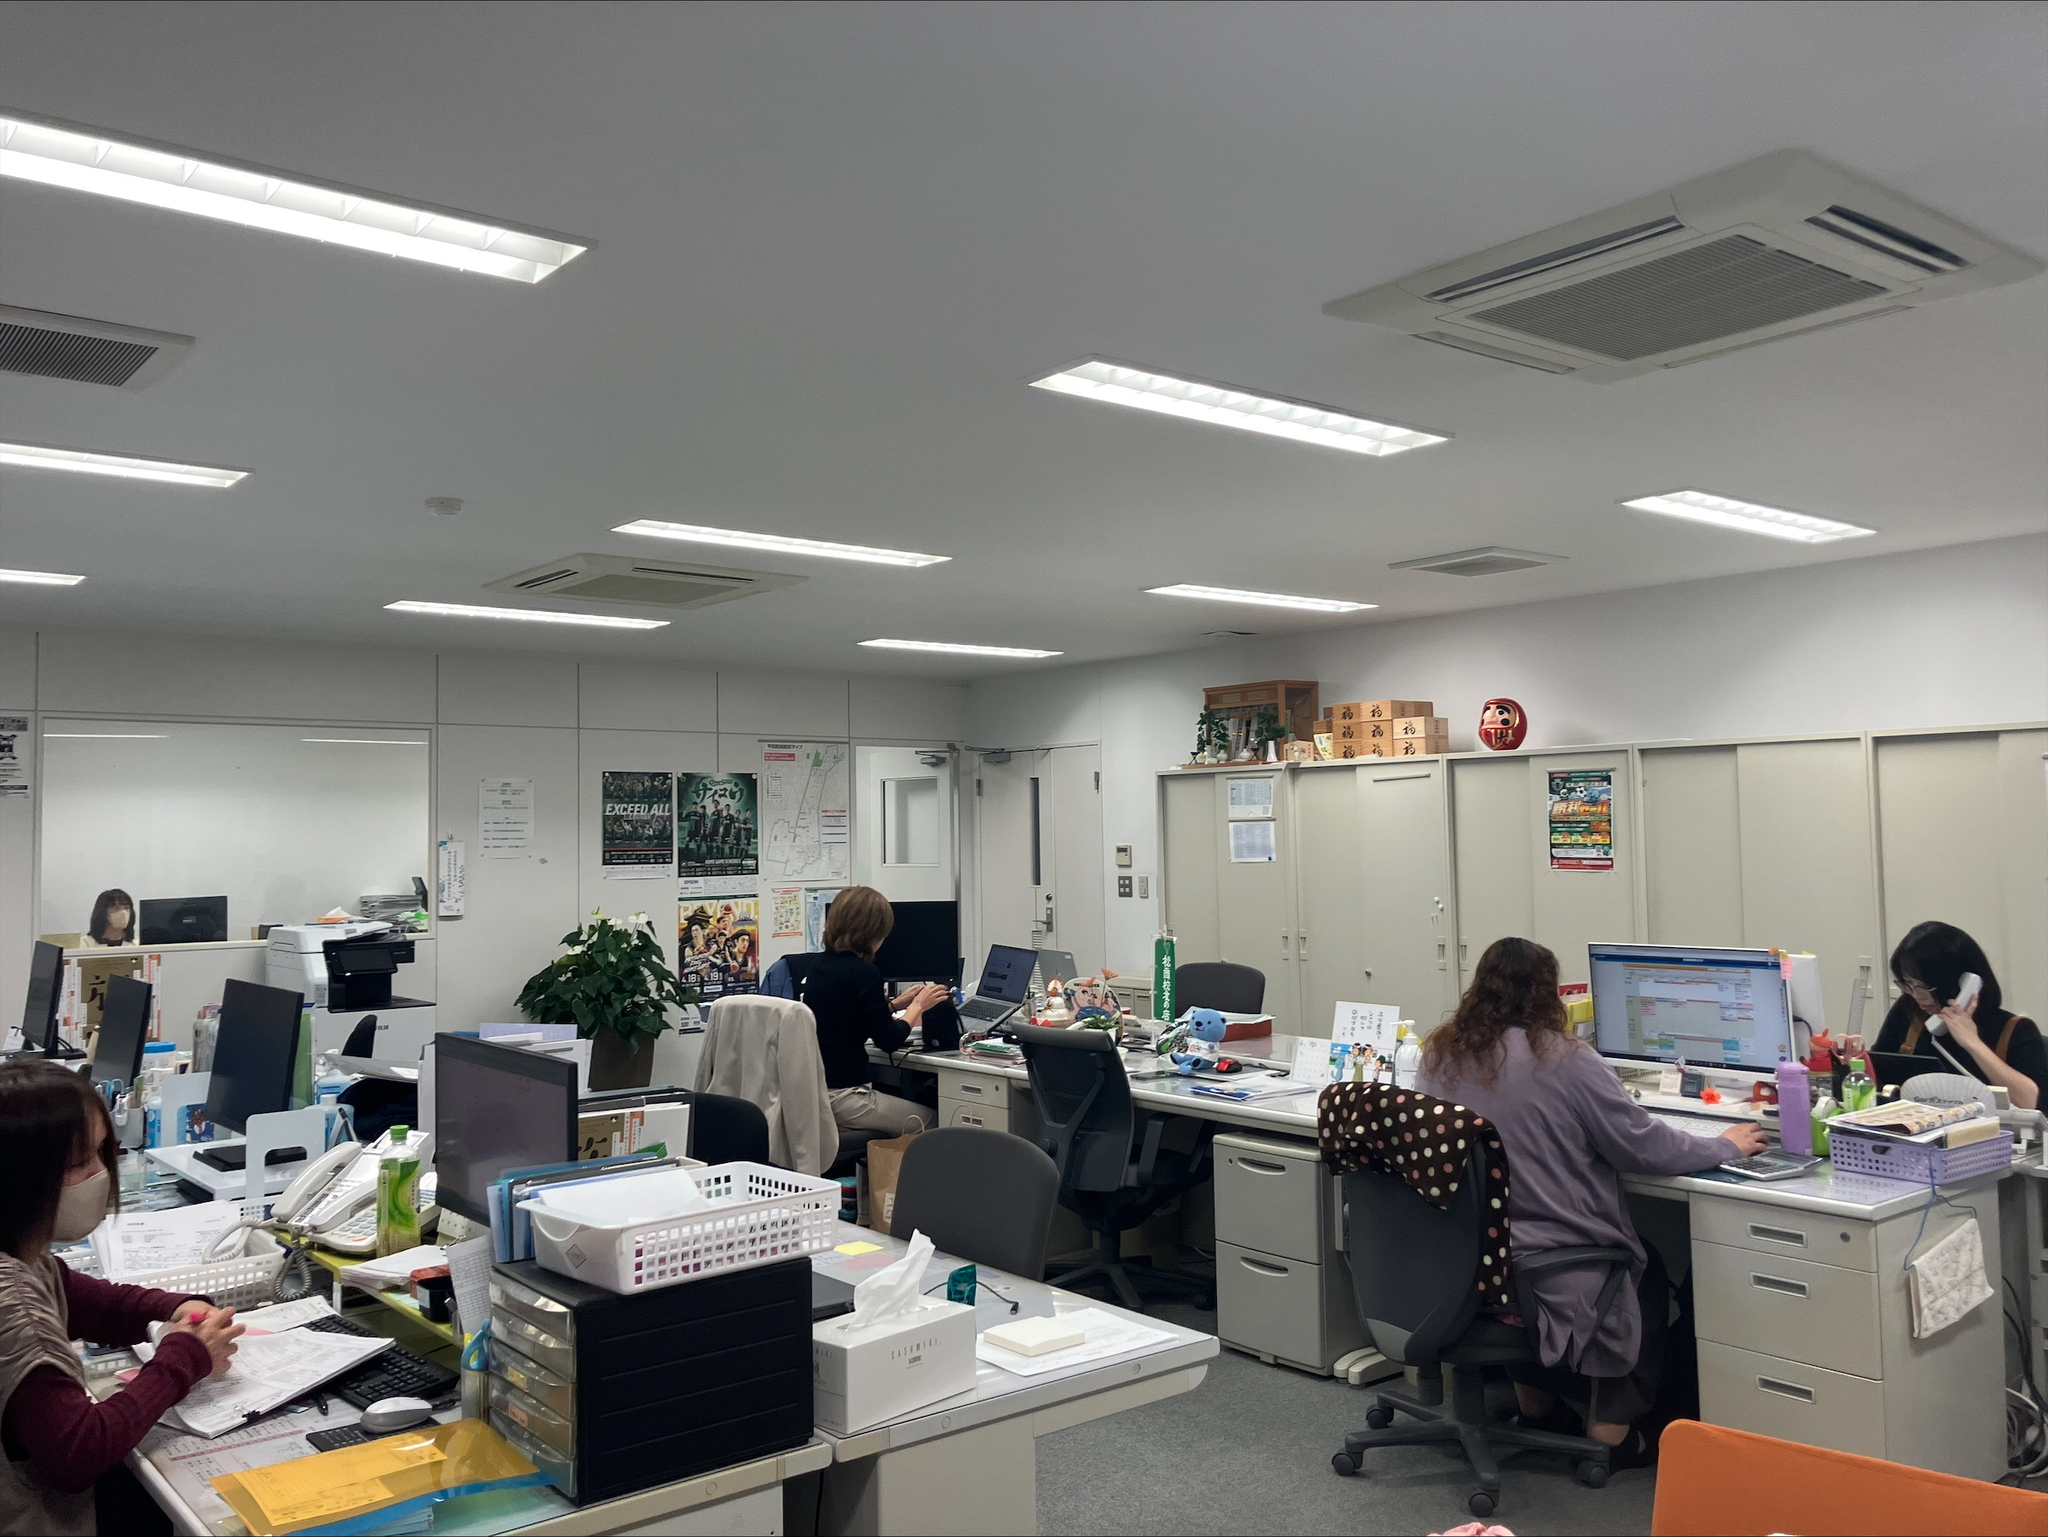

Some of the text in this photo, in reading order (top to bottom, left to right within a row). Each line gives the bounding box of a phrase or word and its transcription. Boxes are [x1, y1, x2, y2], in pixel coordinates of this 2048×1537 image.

[1341, 704, 1382, 720] 福 福
[1342, 721, 1416, 739] 福 福 福
[1403, 741, 1416, 755] 福
[604, 803, 672, 816] EXCEED ALL
[681, 974, 697, 983] 4.18
[703, 972, 719, 981] 4.19
